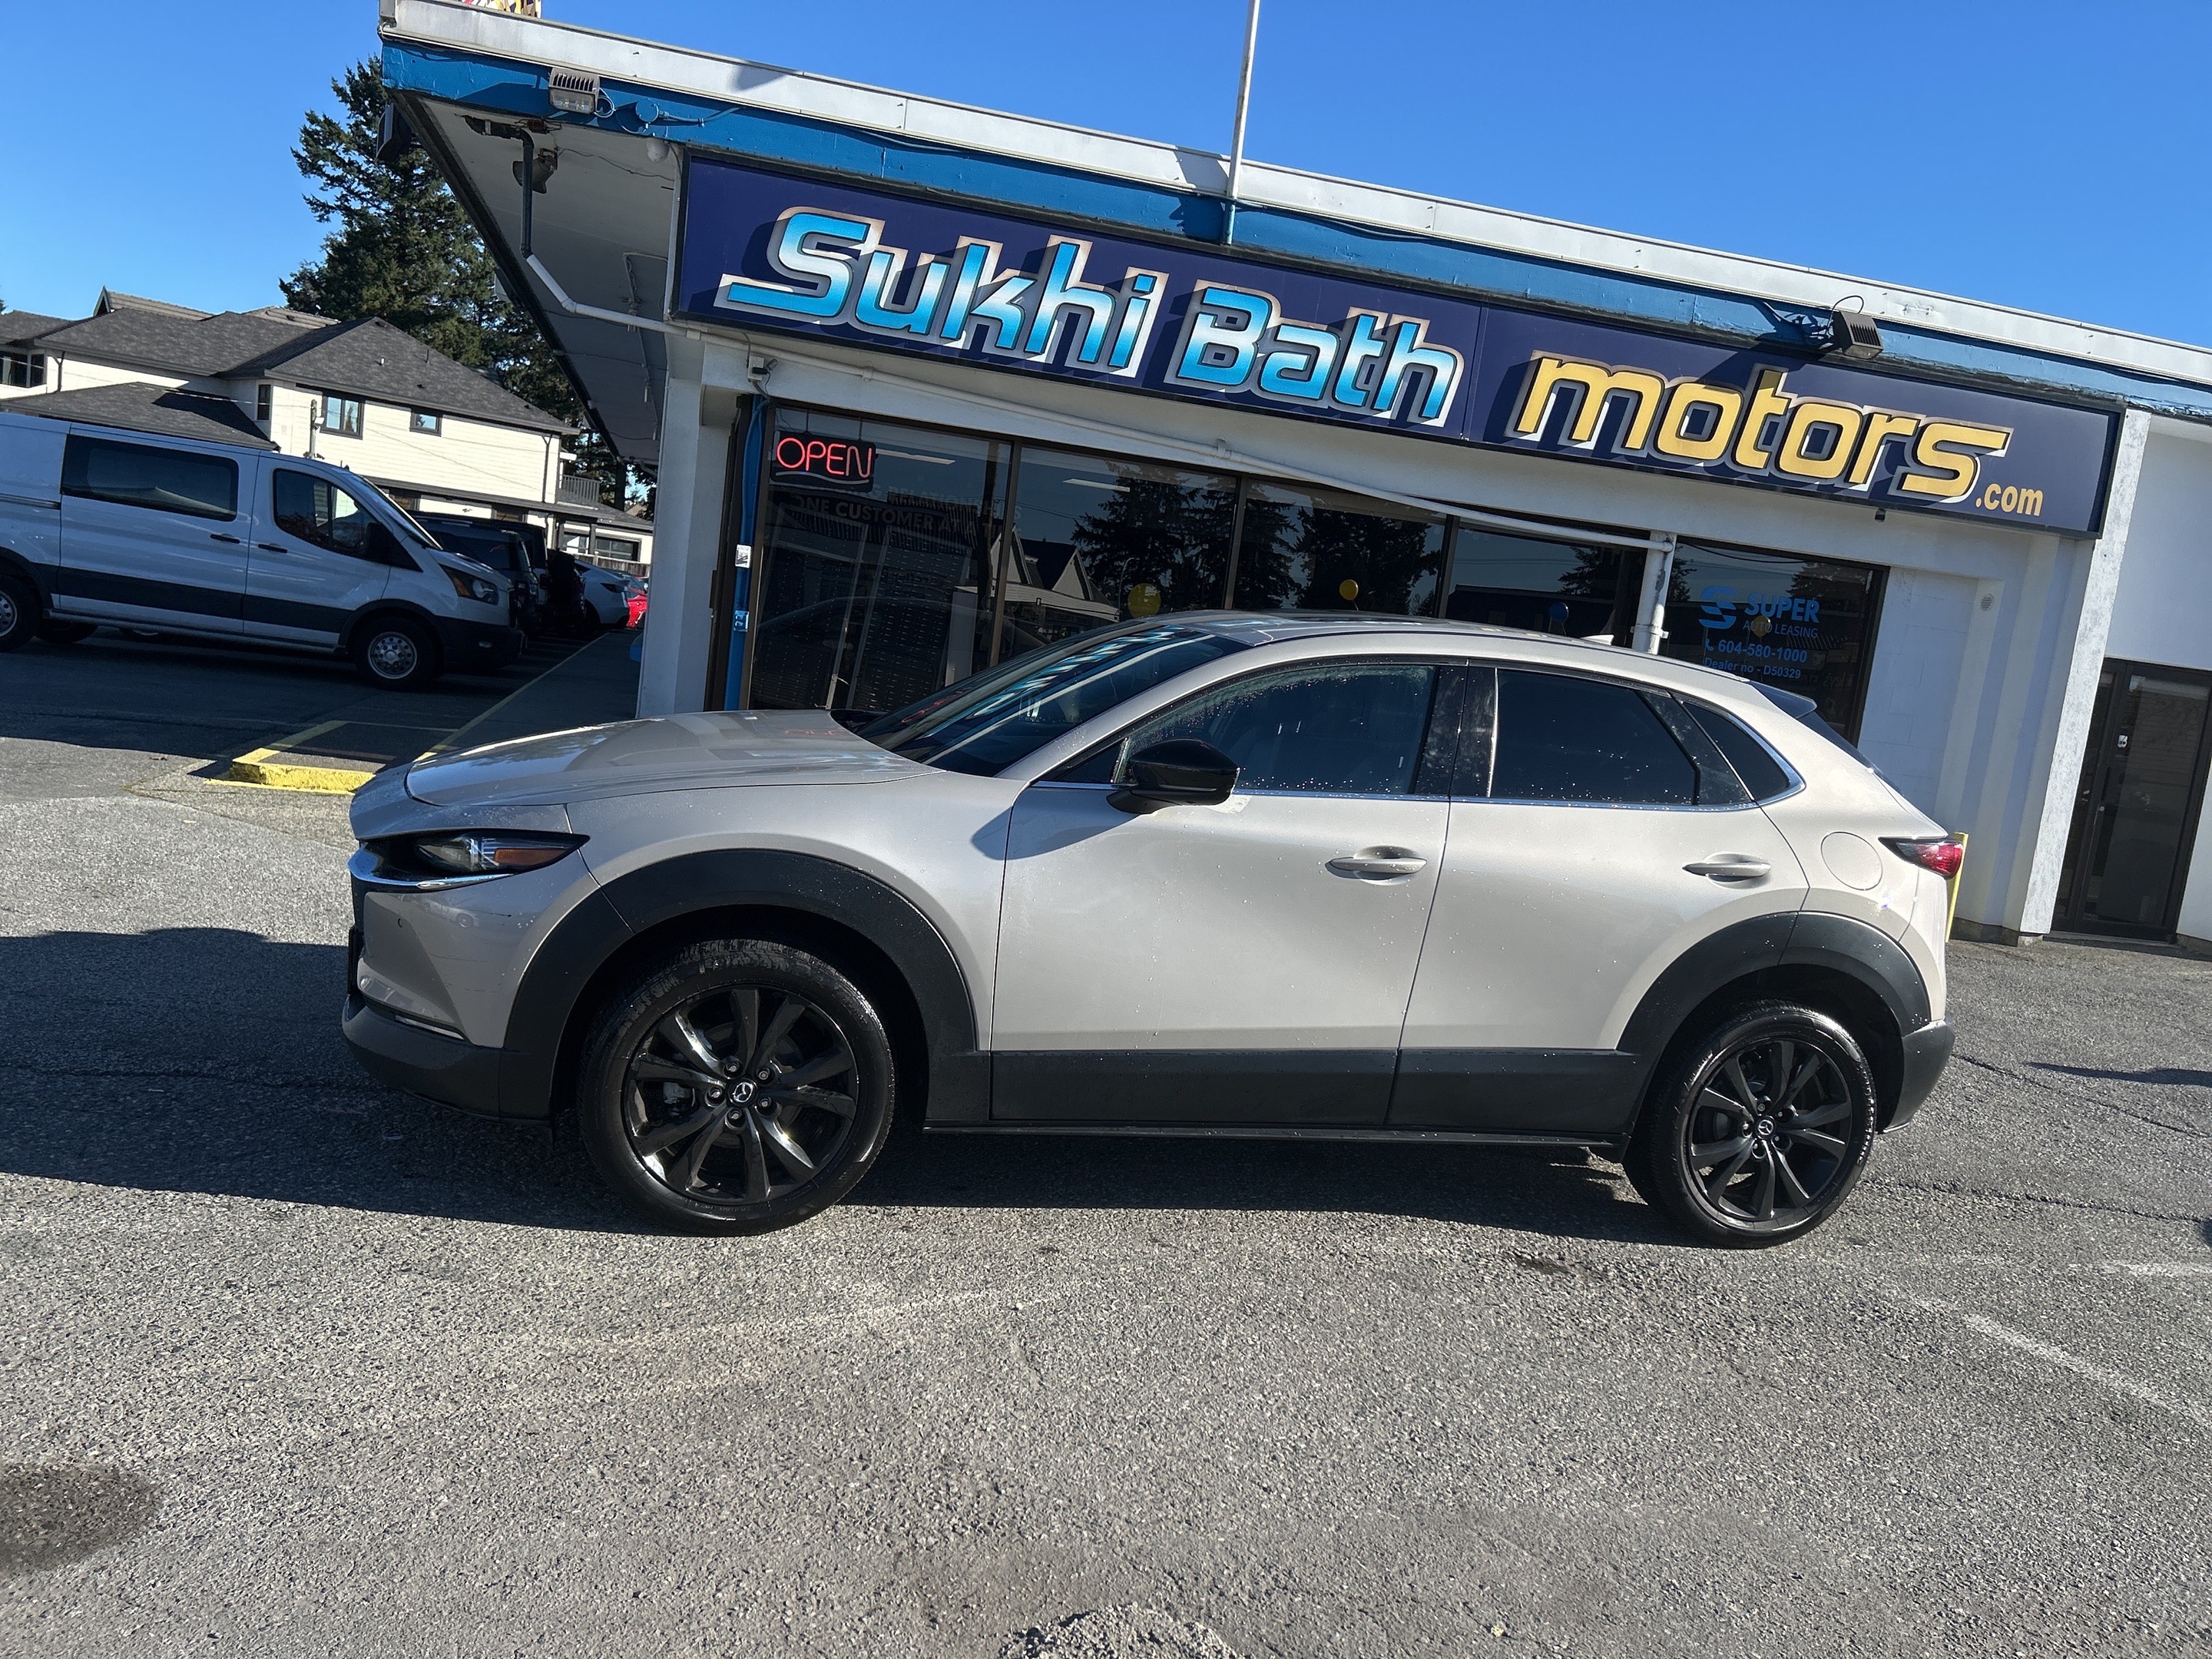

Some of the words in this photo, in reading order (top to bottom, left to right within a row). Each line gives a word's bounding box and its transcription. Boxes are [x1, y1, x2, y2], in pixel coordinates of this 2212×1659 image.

[719, 207, 1164, 376] Sukhi
[1171, 280, 1462, 424] Bath
[1511, 352, 2012, 500] motors
[1976, 480, 2045, 517] .com
[776, 436, 873, 478] OPEN
[835, 501, 935, 531] CUSTOMER
[1743, 591, 1820, 624] SUPER
[1743, 620, 1773, 634] AUTO
[1774, 624, 1819, 639] LEASING
[1717, 638, 1808, 663] 604-580-1000
[1704, 657, 1738, 672] Dealer
[1740, 664, 1754, 674] no
[1763, 665, 1802, 680] D50329
